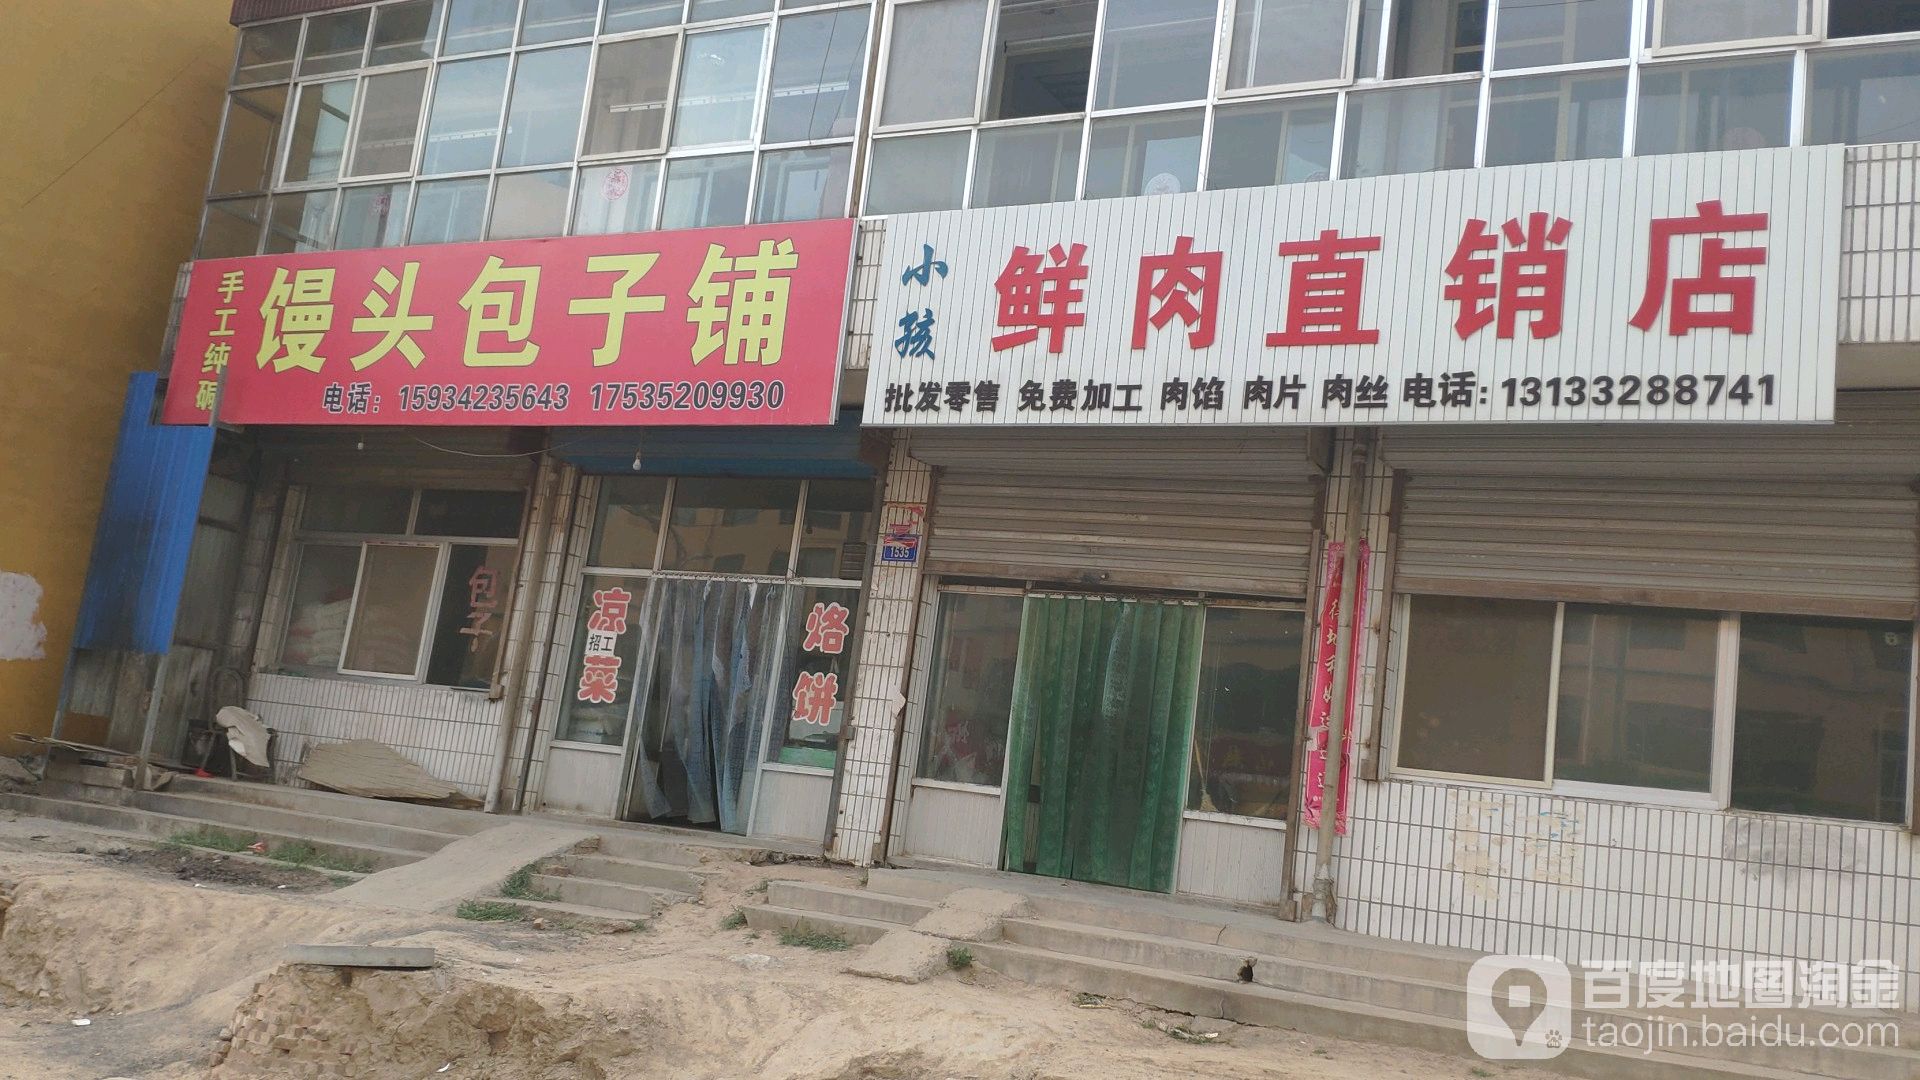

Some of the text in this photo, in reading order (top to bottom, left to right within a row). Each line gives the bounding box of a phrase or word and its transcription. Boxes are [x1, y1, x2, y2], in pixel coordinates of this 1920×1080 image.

[255, 238, 800, 375] 馒头包子铺
[894, 243, 949, 361] 小孩
[992, 199, 1769, 355] 鲜肉直销店
[589, 379, 785, 411] 17535209930
[884, 379, 1001, 413] 批发零售
[1017, 378, 1143, 412] 免费加工
[1159, 375, 1225, 411] 肉馅
[1243, 373, 1307, 410] 肉片
[1321, 372, 1389, 409] 肉丝
[890, 545, 910, 559] 1535
[458, 565, 498, 653] 包子
[577, 587, 632, 703] 凉菜
[588, 632, 614, 652] 招工
[792, 602, 849, 726] 烙饼
